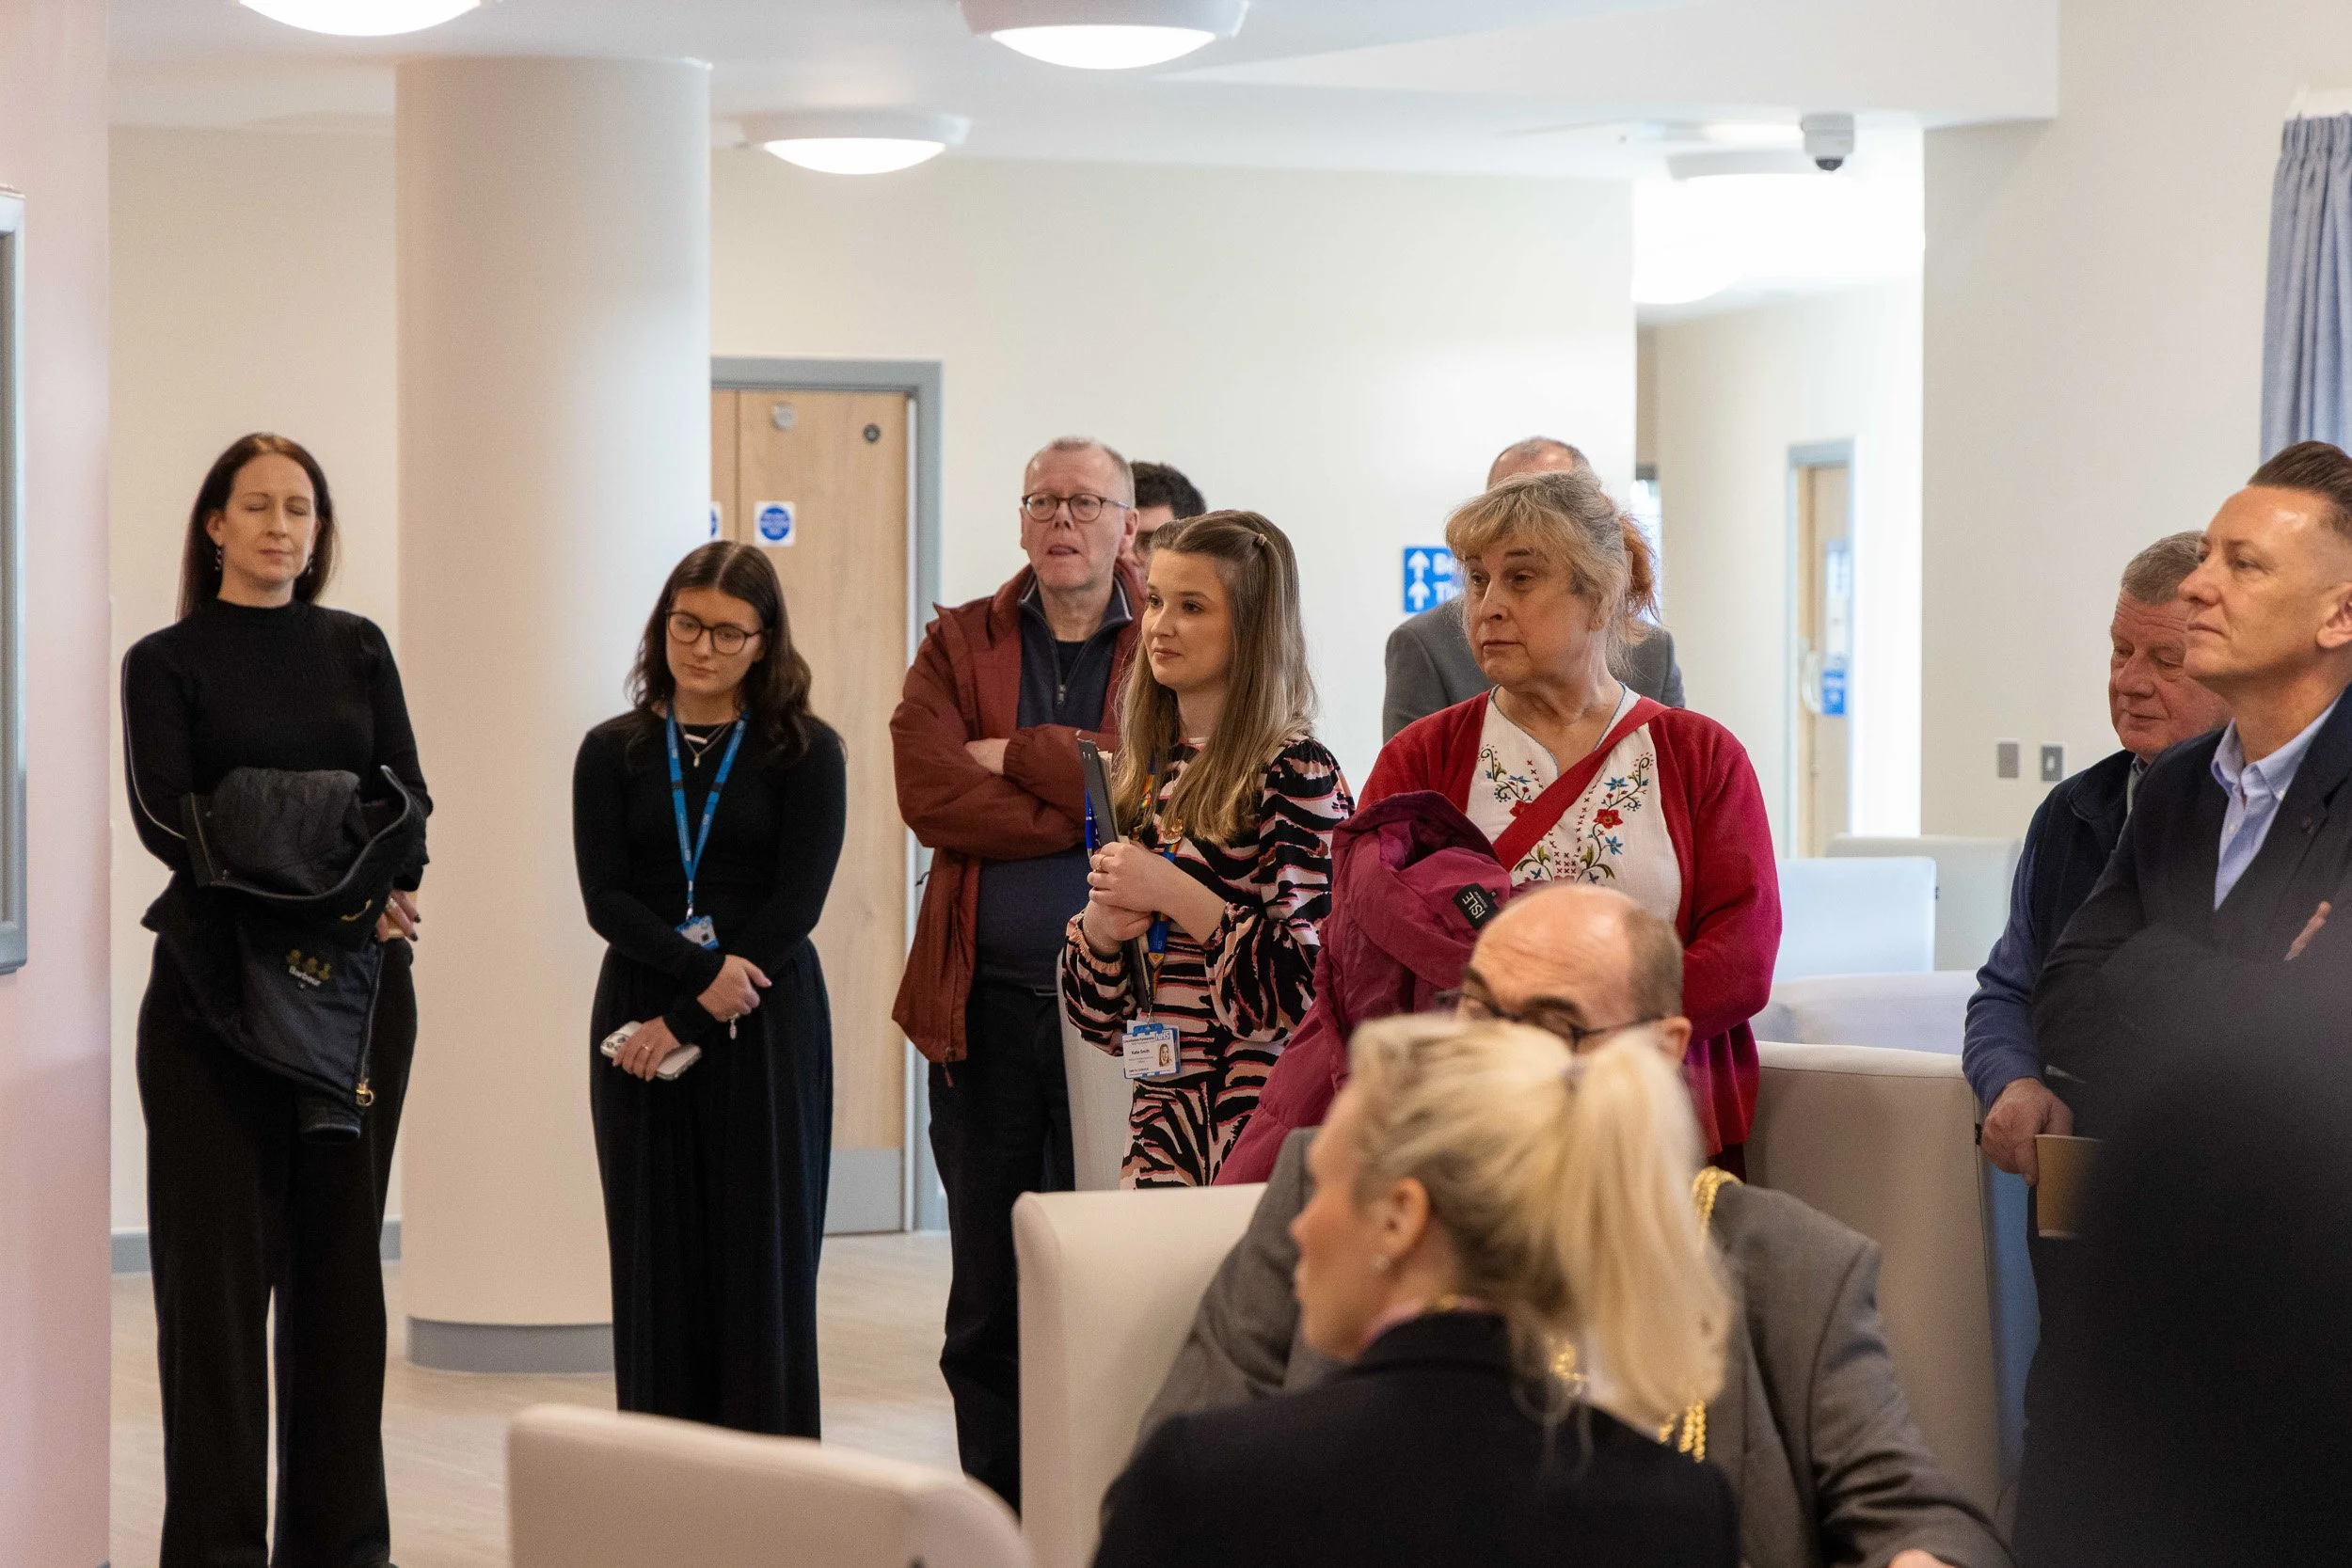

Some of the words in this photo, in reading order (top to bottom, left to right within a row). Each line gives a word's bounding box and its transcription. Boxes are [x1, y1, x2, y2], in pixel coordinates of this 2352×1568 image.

[1462, 891, 1486, 918] ISLE
[289, 965, 322, 987] Barbour
[1155, 1031, 1169, 1040] NHS
